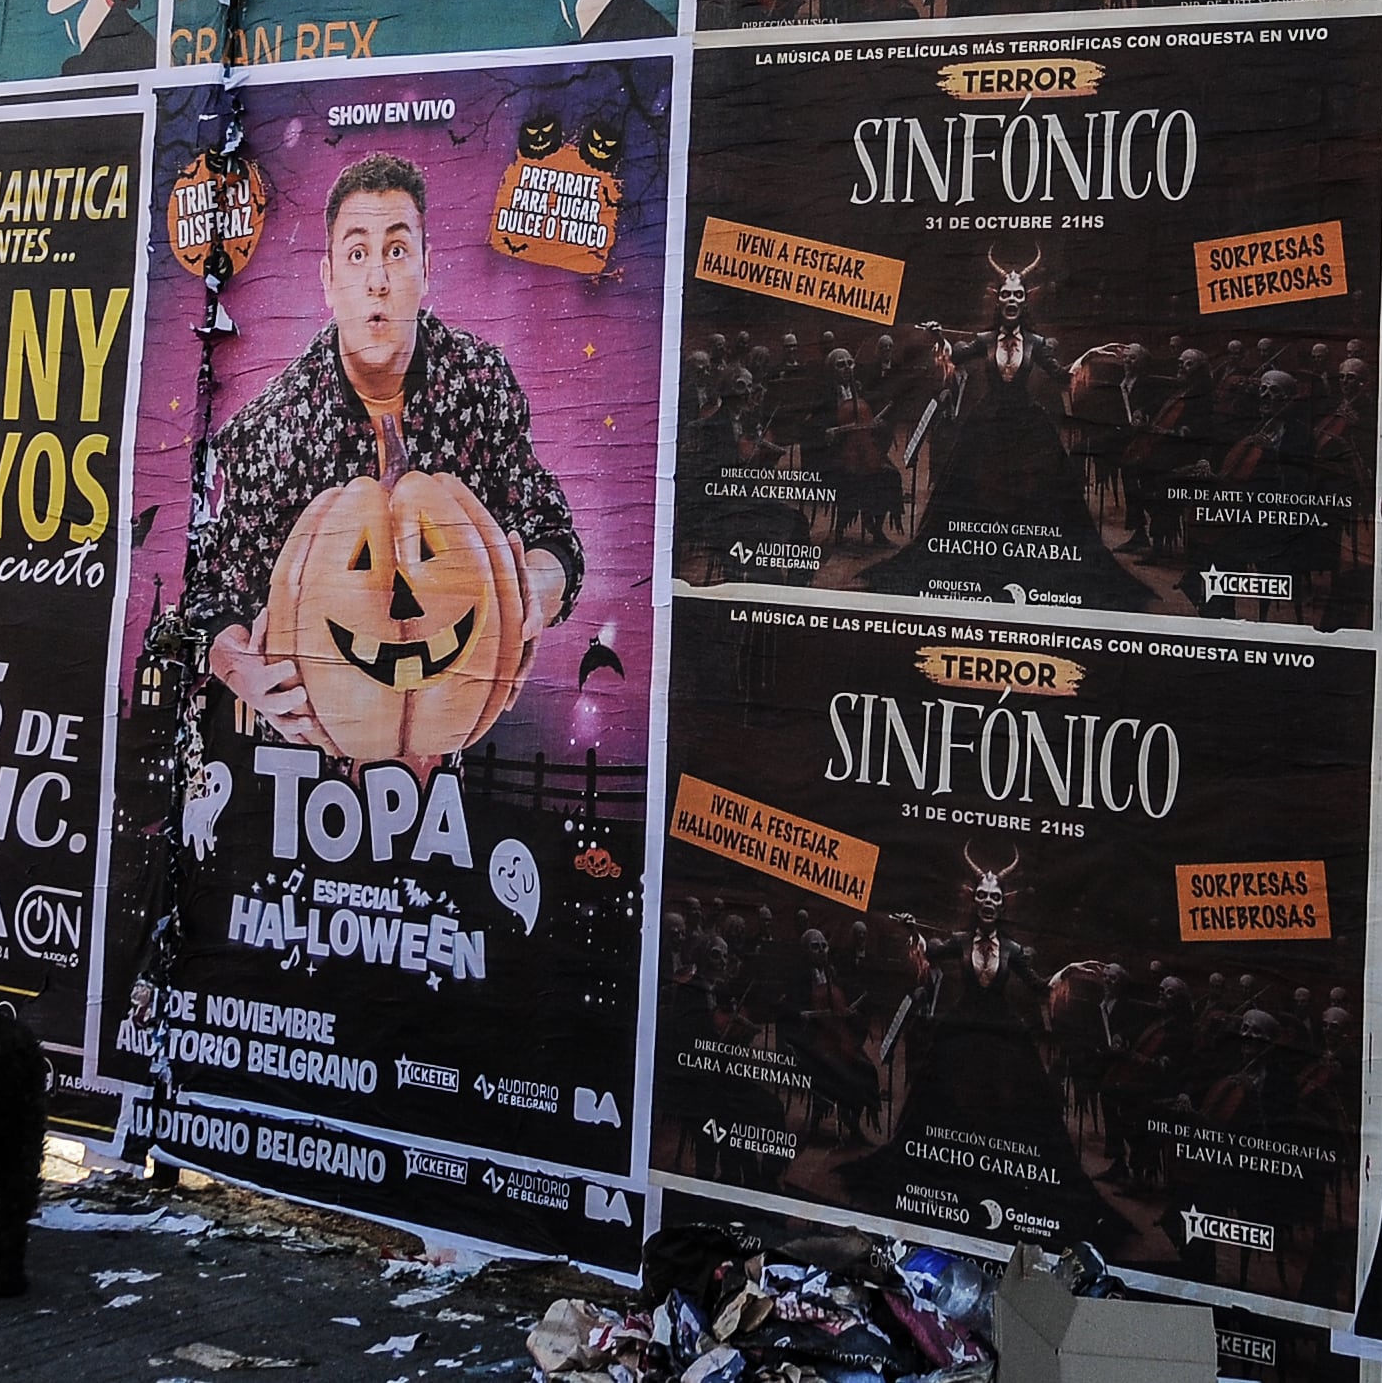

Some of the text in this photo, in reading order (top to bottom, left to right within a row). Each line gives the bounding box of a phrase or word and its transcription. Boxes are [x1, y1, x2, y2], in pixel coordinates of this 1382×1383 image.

[756, 28, 1328, 65] LA MÚSICA DE LAS PELÍCULAS MÁS TERRORÍFICAS CON ORQUESTA EN VIVO
[962, 66, 1077, 94] TERROR
[328, 99, 455, 126] SHOW EN VIVO
[850, 95, 1197, 207] SINFÓNICO
[520, 166, 600, 199] PREPARATE
[512, 188, 600, 223] PARA JUGAR
[498, 209, 606, 248] DULCE O TRUCO
[777, 242, 788, 262] A
[793, 246, 865, 280] FESTEJAR
[704, 252, 892, 315] HALLOWEEN EN FAMILIA!
[705, 483, 836, 502] CLARA ACKERMANN
[1195, 507, 1251, 524] FLAVIA
[927, 537, 1082, 562] CHACHO GARABAL
[1200, 563, 1293, 603] TICKETEK
[14, 708, 84, 763] DE
[825, 687, 1180, 819] SINFÓNICO
[254, 745, 473, 869] TOPA
[313, 879, 403, 913] ESPECIAL
[228, 894, 486, 980] HALLOWEEN
[248, 1041, 377, 1094] BELGRANO
[395, 1054, 459, 1092] TICKETEK
[497, 1077, 559, 1101] AUDITORIO
[497, 1093, 558, 1113] DE BELGRANO
[905, 1184, 959, 1204] ORQUESTA
